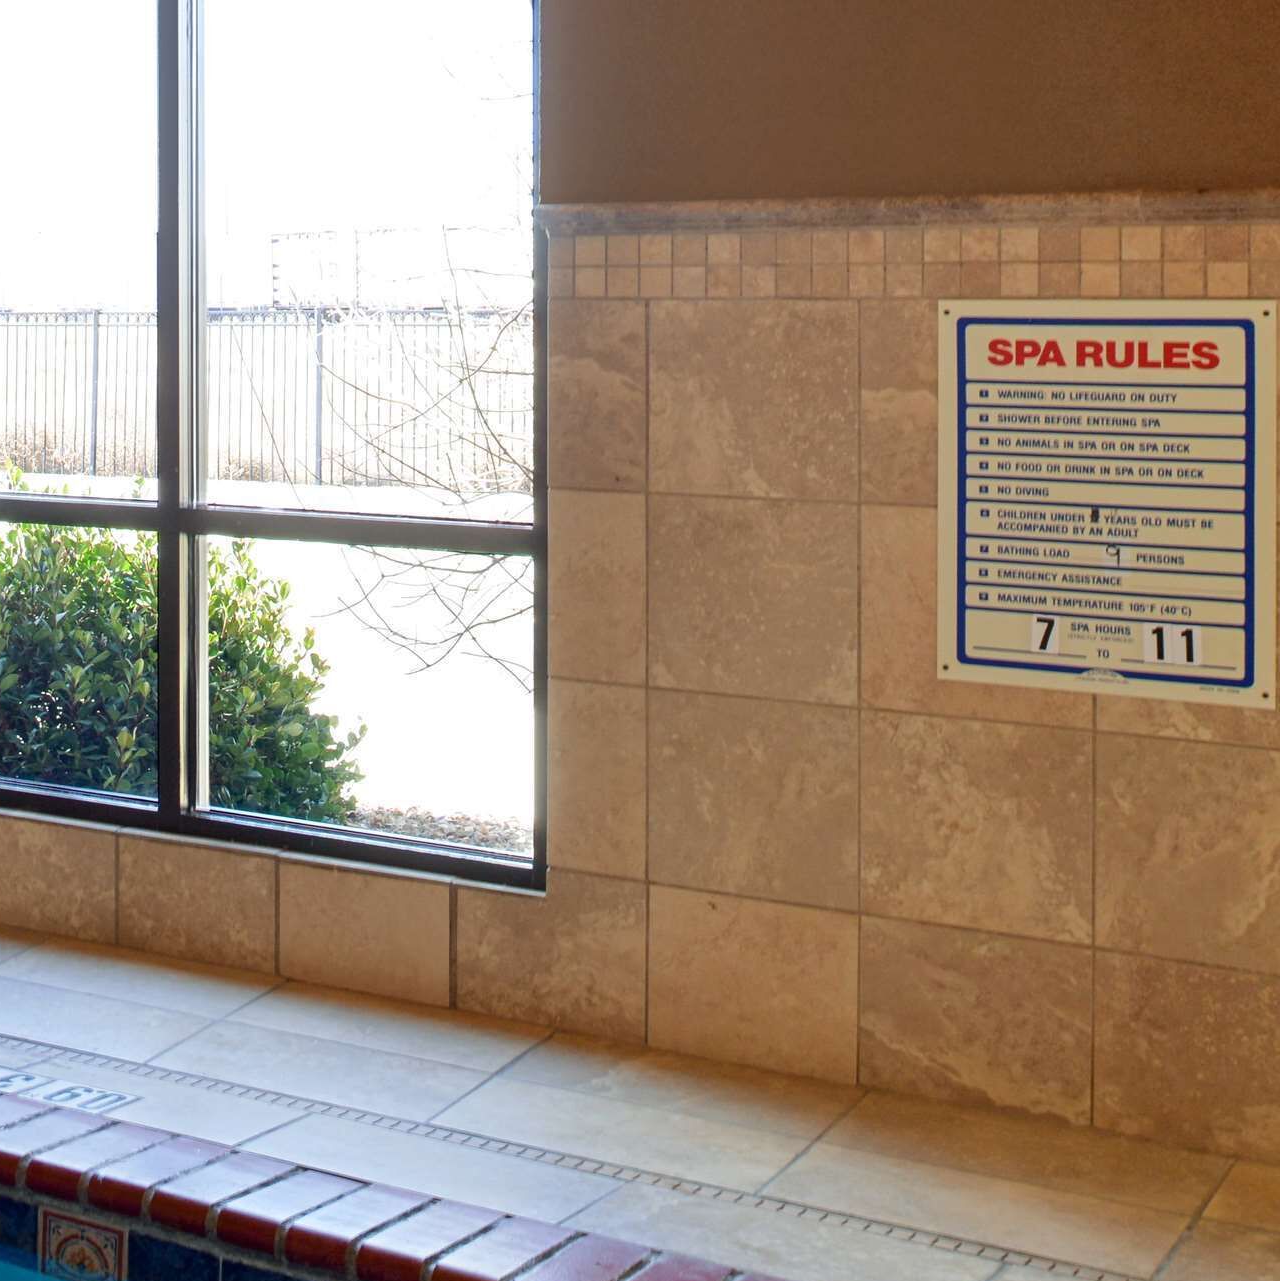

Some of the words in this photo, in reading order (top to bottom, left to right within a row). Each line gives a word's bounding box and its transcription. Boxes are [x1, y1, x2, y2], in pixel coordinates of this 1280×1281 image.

[988, 339, 1067, 367] SPA
[1076, 340, 1221, 370] RULES
[1051, 390, 1066, 401] NO
[1070, 391, 1126, 402] LIFEGUARD
[1130, 392, 1145, 403] ON
[1149, 393, 1178, 404] DUTY
[997, 413, 1041, 425] SHOWER
[1044, 414, 1083, 426] BEFORE
[1086, 415, 1137, 427] ENTERING
[1141, 416, 1161, 428] SPA
[997, 437, 1011, 447] NO
[1015, 438, 1060, 450] ANIMALS
[1063, 439, 1074, 450] IN
[1078, 439, 1097, 450] SPA
[1101, 440, 1116, 451] OR
[1120, 441, 1135, 452] ON
[1139, 442, 1159, 453] SPA
[1163, 443, 1191, 454] DECK
[997, 461, 1011, 471] NO
[1015, 462, 1042, 473] FOOD
[1046, 463, 1061, 473] OR
[1065, 464, 1096, 475] DRINK
[1100, 465, 1111, 475] IN
[1115, 466, 1135, 477] SPA
[1138, 467, 1153, 477] OR
[1157, 467, 1173, 478] ON
[1176, 468, 1205, 479] DECK
[997, 485, 1011, 495] NO
[1015, 486, 1050, 497] DIVING
[997, 508, 1046, 521] CHILDREN
[1050, 510, 1085, 523] UNDER
[1103, 514, 1138, 526] YEARS
[1141, 516, 1162, 527] OLD
[1166, 516, 1197, 529] MUST
[1200, 518, 1215, 530] BE
[997, 521, 1069, 534] ACCOMPANIED
[1072, 525, 1085, 535] BY
[1089, 526, 1103, 536] AN
[1107, 527, 1139, 538] ADULT
[997, 544, 1040, 557] BATHING
[1043, 547, 1070, 559] LOAD
[1136, 553, 1185, 565] PERSONS
[997, 569, 1058, 582] EMERGENCY
[1061, 573, 1122, 586] ASSISTANCE
[997, 593, 1048, 605] MAXIMUM
[1052, 595, 1124, 611] TEMPERATURE
[1036, 617, 1055, 651] 7
[1070, 622, 1090, 633] SPA
[1095, 624, 1131, 636] HOURS
[1096, 649, 1110, 659] TO
